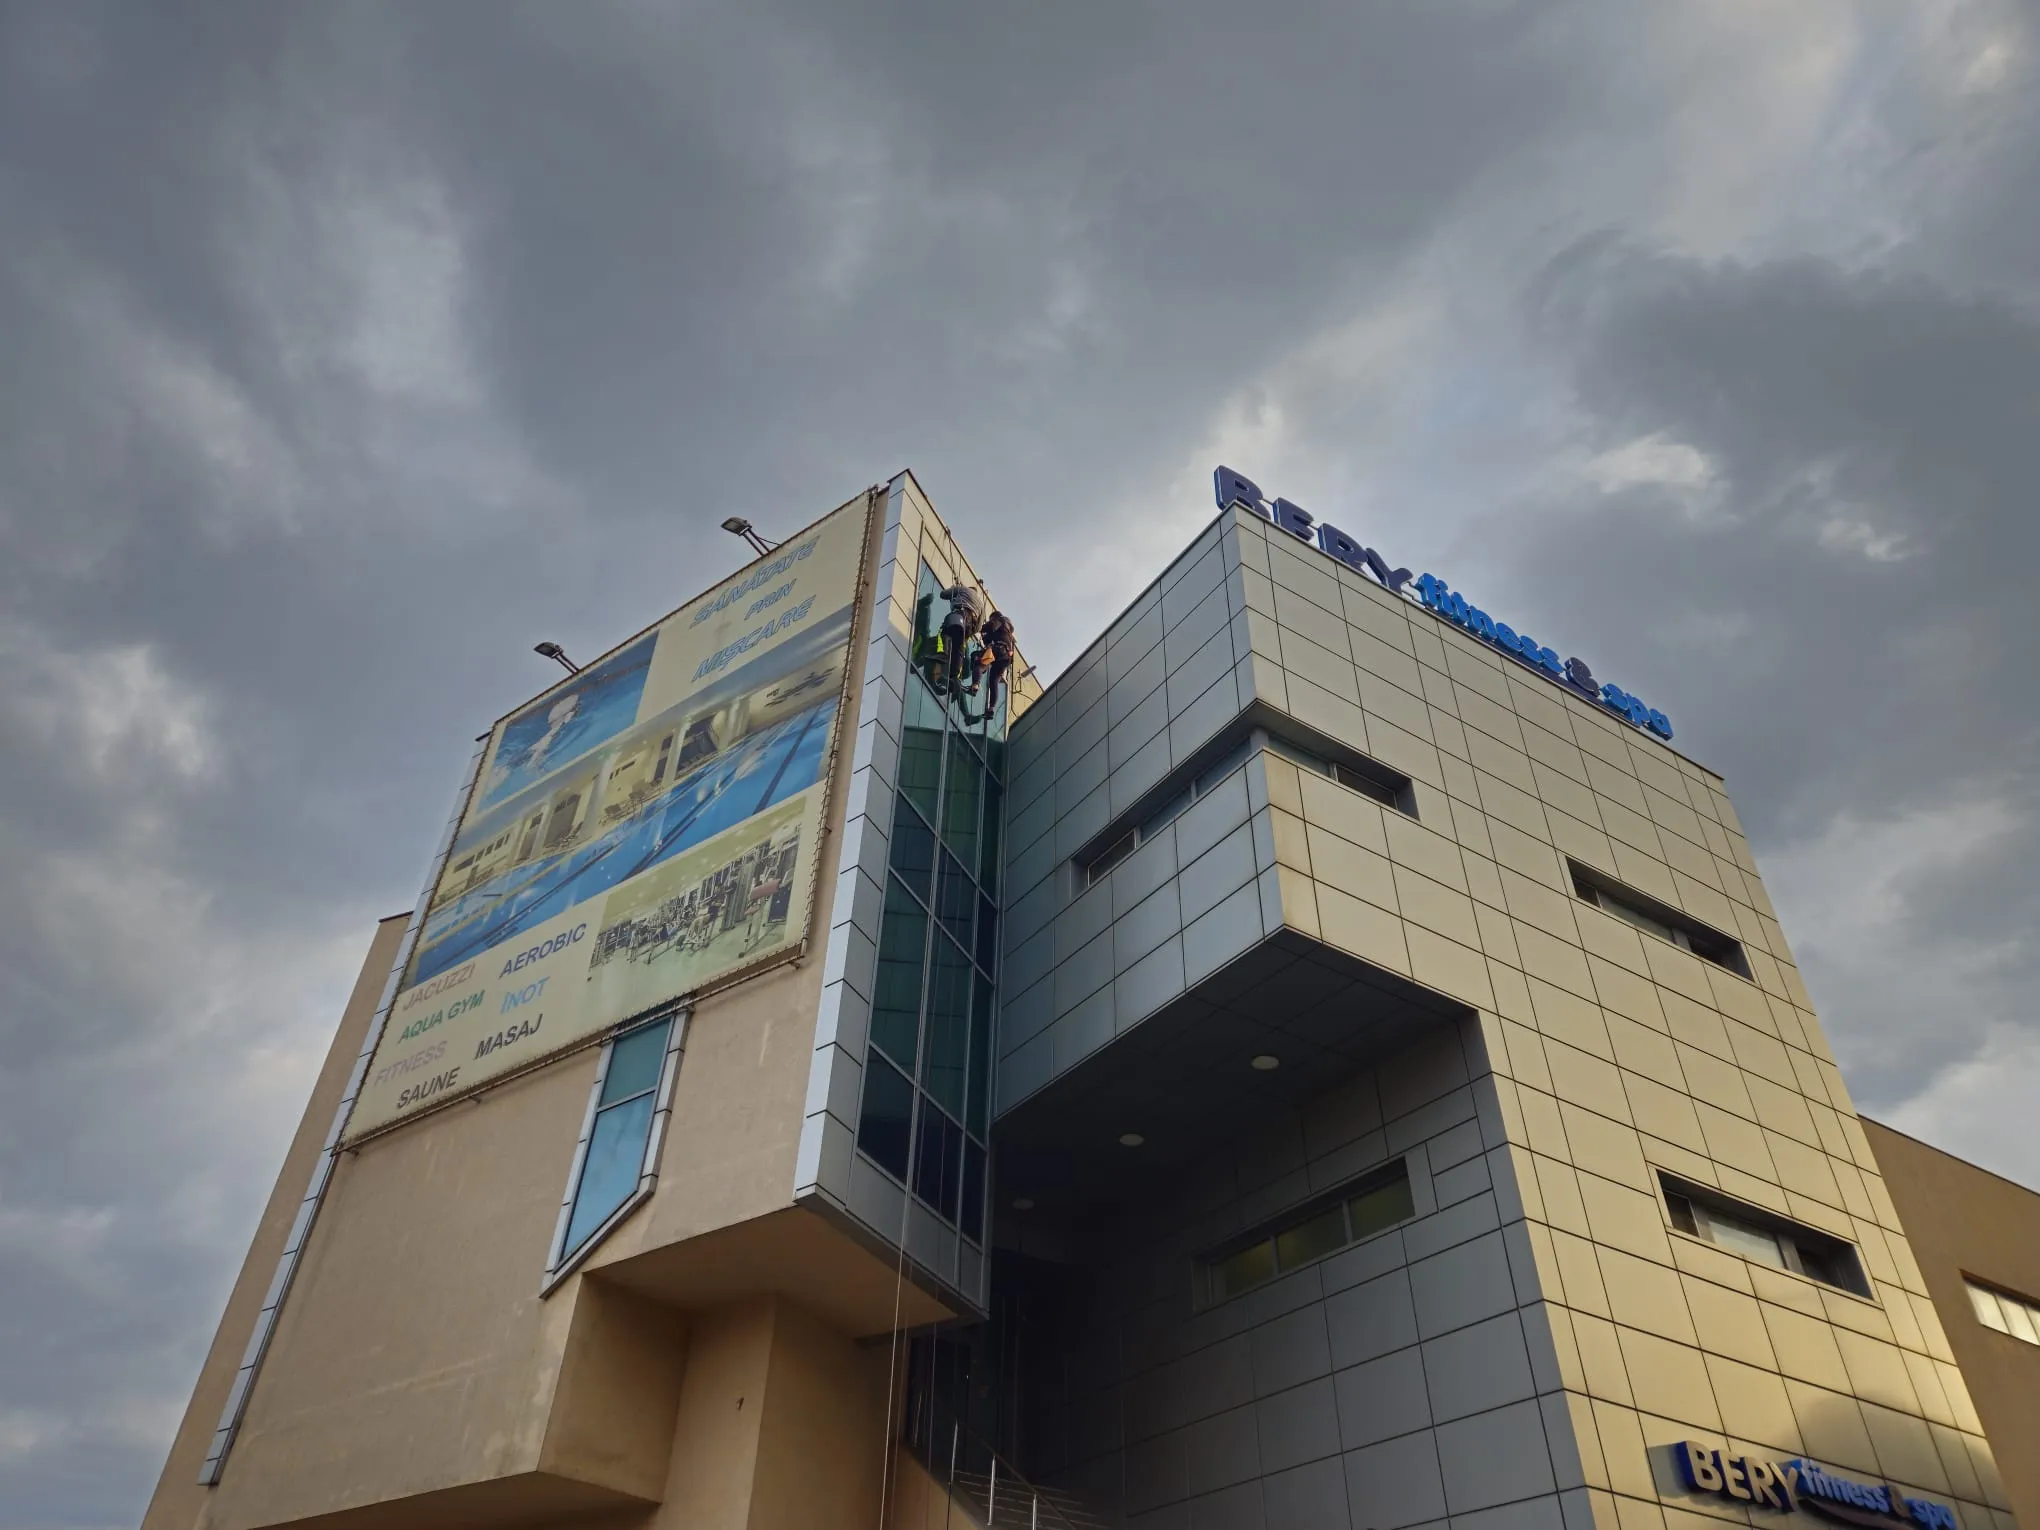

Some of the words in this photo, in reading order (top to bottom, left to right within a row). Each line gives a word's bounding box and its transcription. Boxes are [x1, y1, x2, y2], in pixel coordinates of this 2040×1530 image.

[1213, 464, 1414, 594] BERY
[1414, 572, 1567, 675] fitness
[1600, 683, 1675, 741] spa
[498, 922, 588, 979] AEROBIC
[402, 961, 477, 1012] JACUZZI
[397, 1010, 444, 1044] AQUA
[447, 990, 487, 1020] GYM
[473, 1013, 544, 1061] MASAJ
[374, 1040, 448, 1087] FITNESS
[396, 1066, 462, 1109] SAUNE
[1678, 1440, 1801, 1513] BERY
[1798, 1458, 1891, 1514] fitness
[1910, 1497, 1957, 1530] spa
